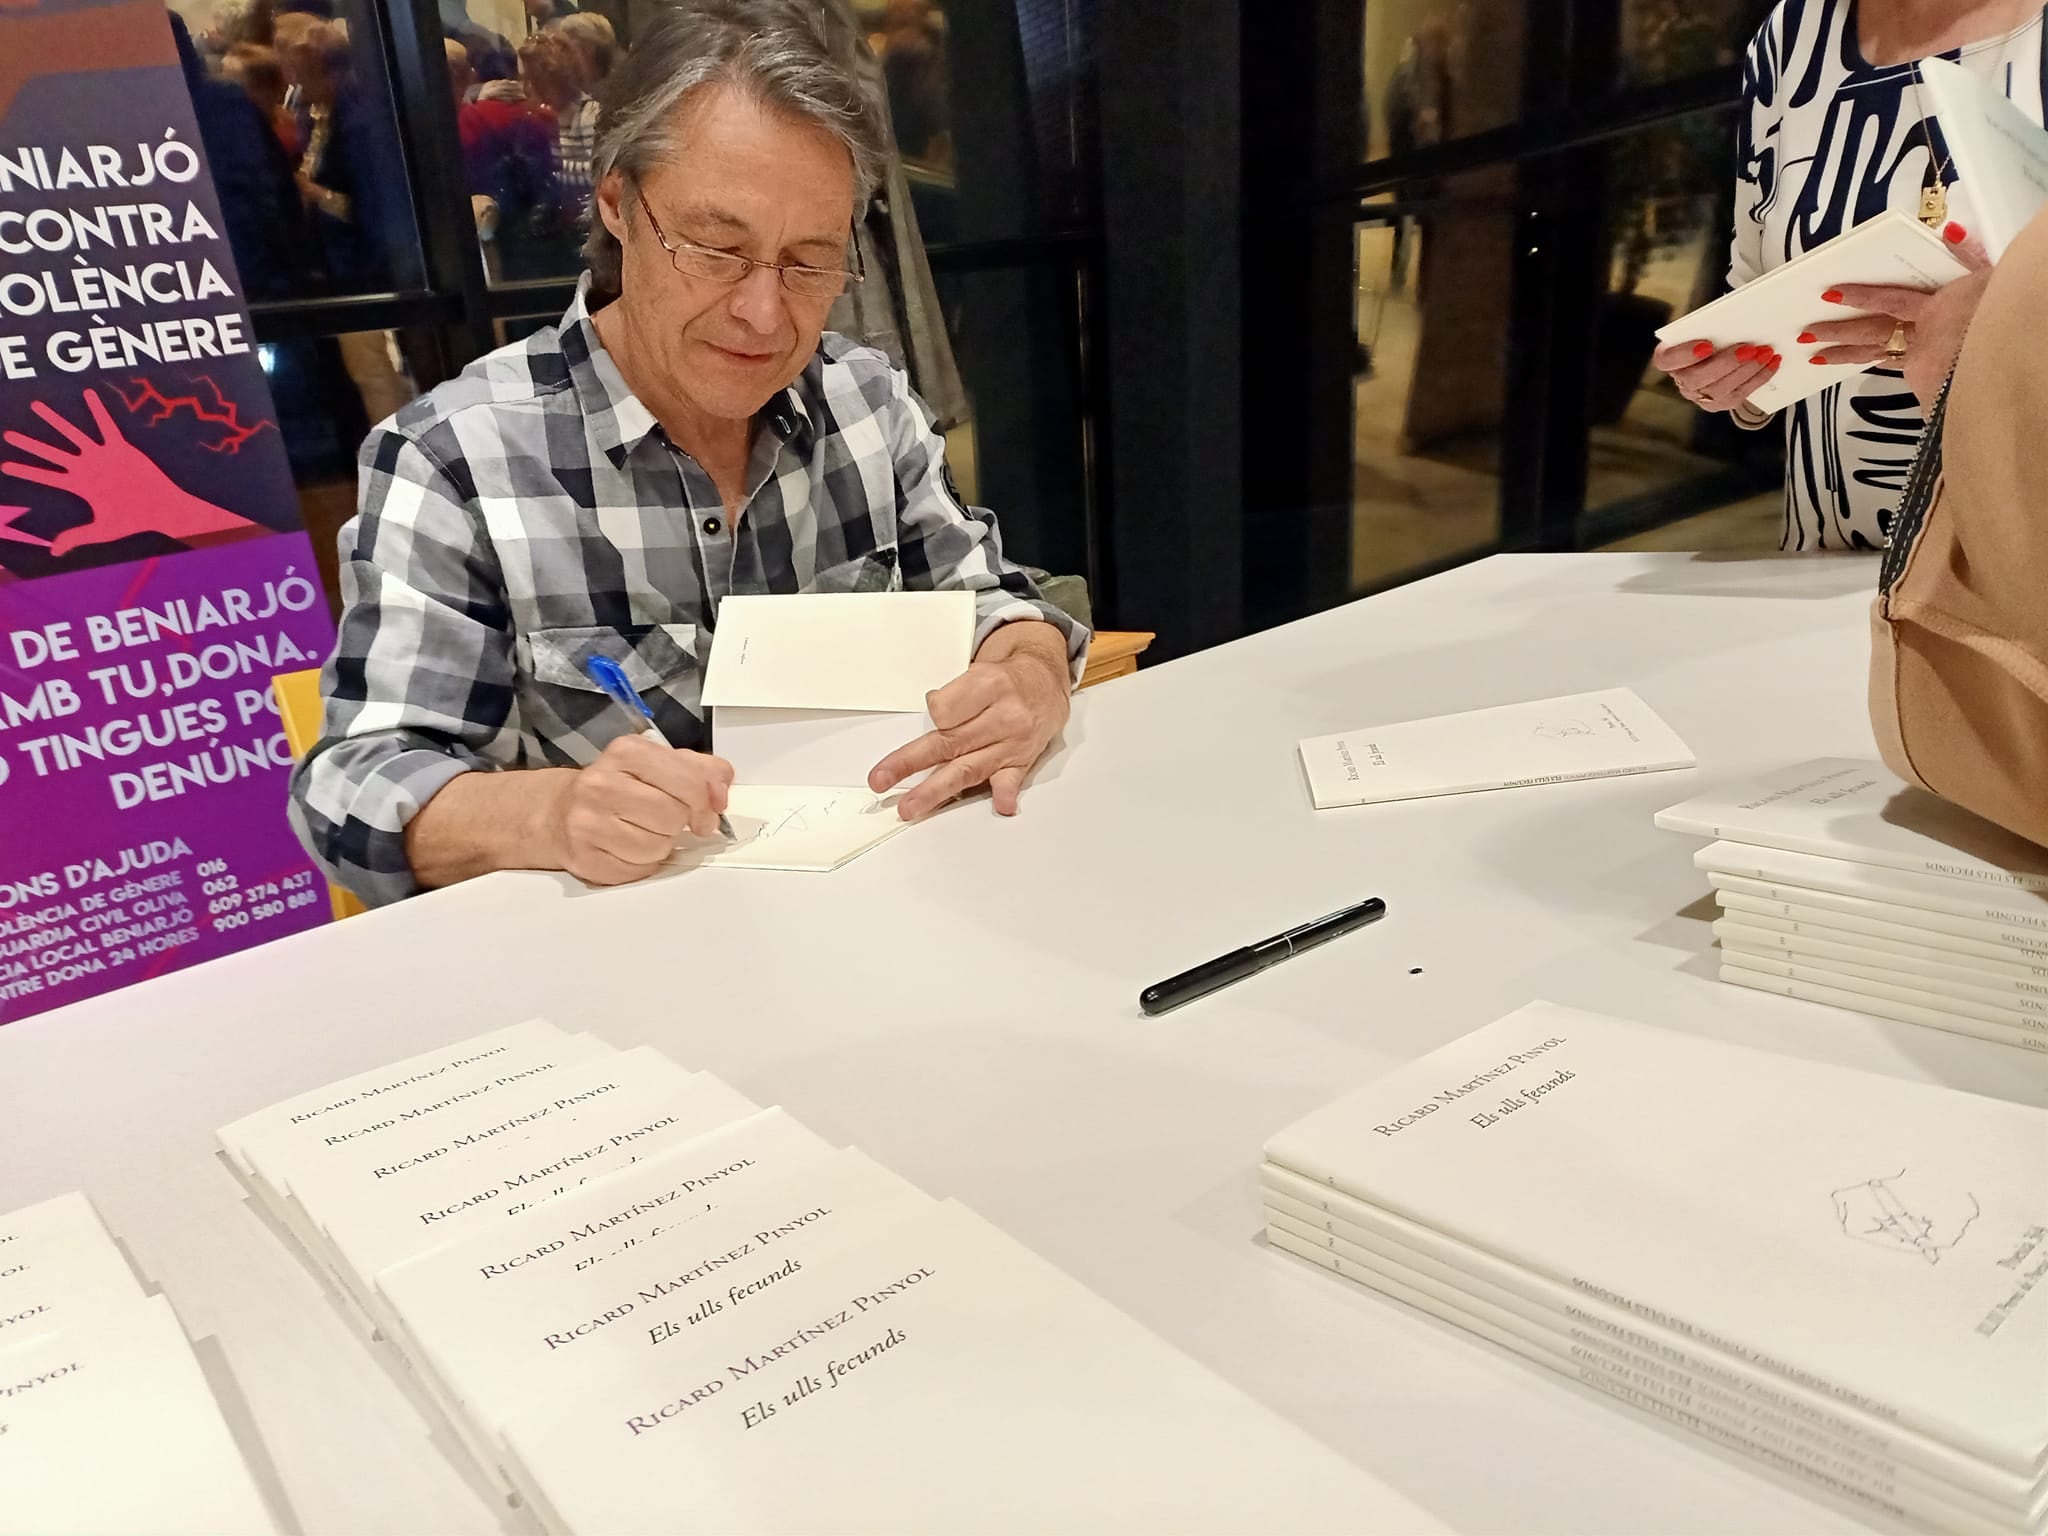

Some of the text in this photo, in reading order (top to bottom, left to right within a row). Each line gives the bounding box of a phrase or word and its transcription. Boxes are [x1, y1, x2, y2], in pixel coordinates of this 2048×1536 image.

[0, 126, 199, 192] NIARJÓ
[0, 200, 219, 254] CONTRA
[0, 254, 235, 318] OLÈNCIA
[0, 313, 251, 380] E GÈNERE
[9, 565, 316, 669] DE BENIARJÓ
[17, 698, 228, 776] TINGUES
[109, 732, 297, 810] DENÚNC
[63, 836, 193, 889] D'AJUDA
[80, 890, 108, 912] DE
[109, 870, 183, 902] GÈNERE
[196, 858, 228, 878] 016
[31, 939, 98, 971] LOCAL
[100, 908, 194, 948] BENIARJÓ
[208, 893, 243, 914] 609
[246, 883, 279, 904] 374
[282, 871, 313, 890] 437
[46, 960, 107, 986] DONA
[109, 949, 137, 967] 24
[139, 927, 200, 957] HORES
[213, 913, 250, 933] 900
[252, 900, 284, 920] 580
[287, 890, 318, 909] 888
[82, 910, 132, 933] CIVIL
[133, 892, 189, 916] OLIVA
[202, 875, 239, 896] 062
[290, 1046, 511, 1125] RICARD MARTÍNEZ PINYOL
[323, 1062, 559, 1147] RICARD MARTÍNEZ PINYOL
[1373, 1037, 1567, 1137] RICARD MARTÍNEZ PINYOL
[1469, 1069, 1576, 1129] Els ulls fecunds
[372, 1081, 621, 1180] RICARD MARTÍNEZ PINYOL
[418, 1187, 500, 1226] RICARD
[502, 1143, 609, 1192] MARTÍNEZ
[608, 1114, 680, 1148] PINYOL
[479, 1239, 566, 1281] RICARD
[569, 1190, 682, 1243] MARTÍNEZ
[680, 1158, 757, 1194] PINYOL
[0, 1304, 51, 1329] YOL
[543, 1302, 635, 1351] RICARD
[637, 1246, 757, 1307] MARTÍNEZ
[754, 1206, 833, 1248] PINYOL
[648, 1258, 803, 1347] Els ulls fecunds
[624, 1265, 936, 1438] RICARD MARTÍNEZ PINYOL
[740, 1328, 907, 1431] Els ulls fecunds
